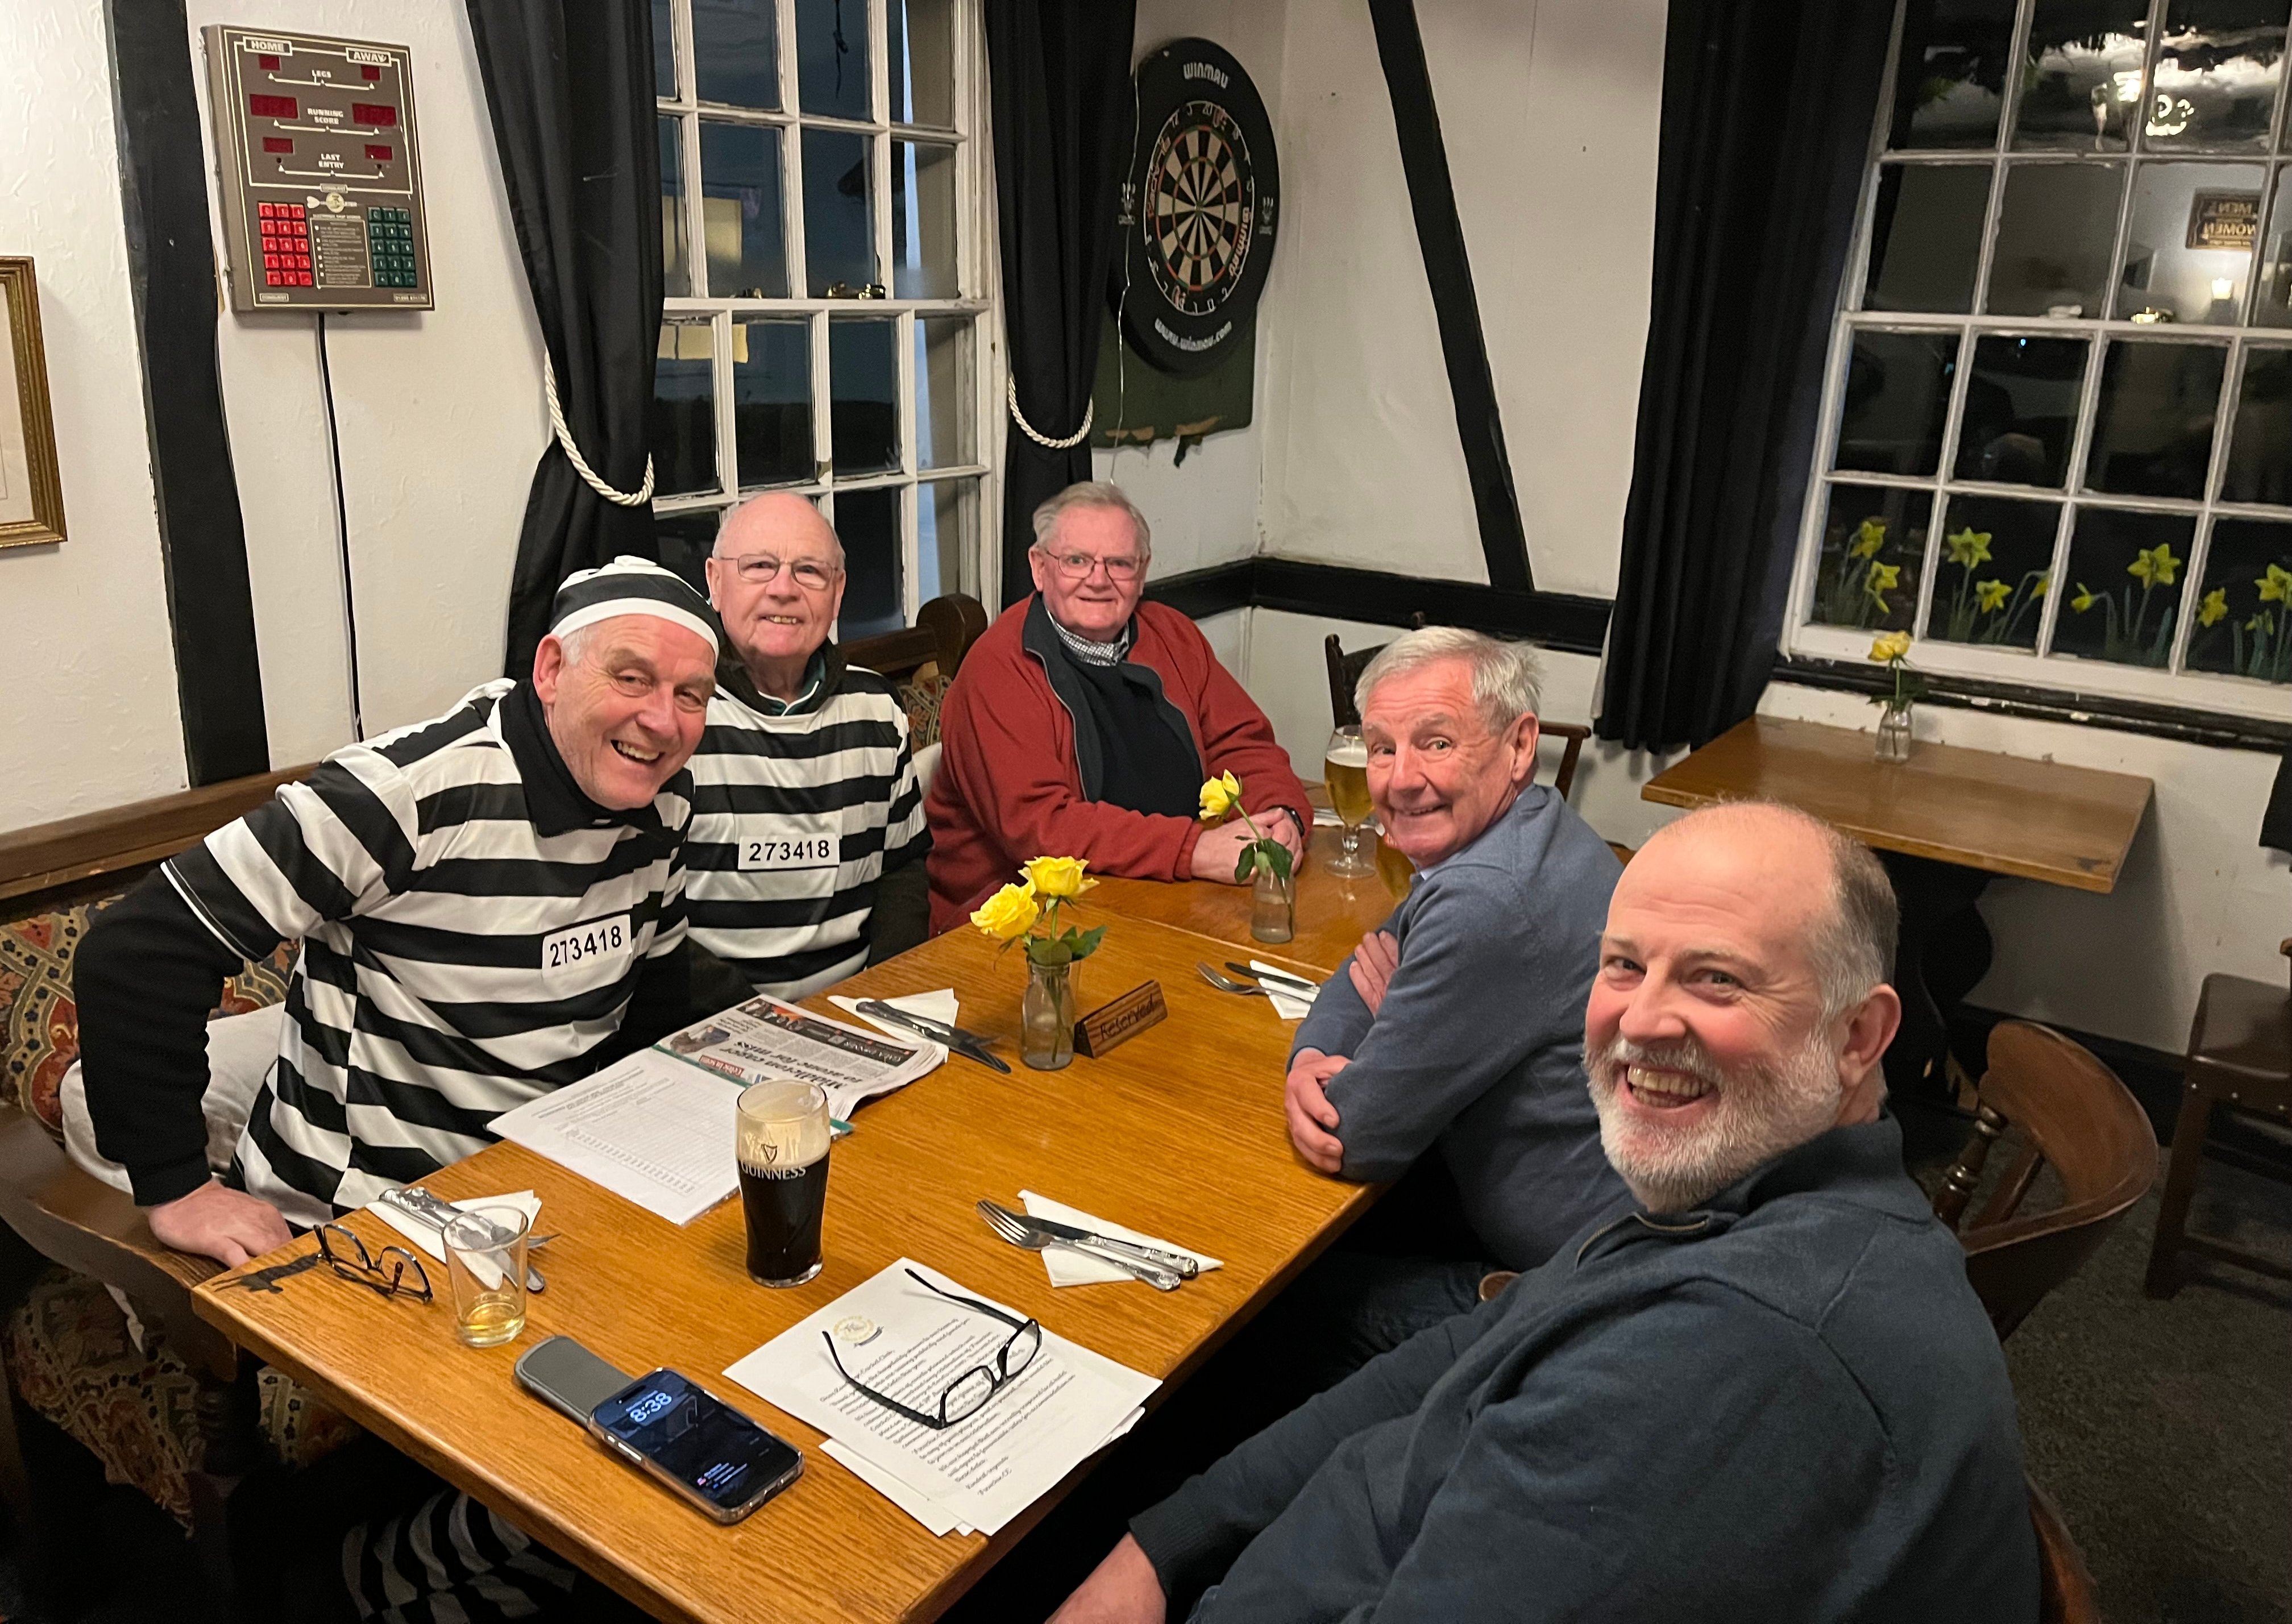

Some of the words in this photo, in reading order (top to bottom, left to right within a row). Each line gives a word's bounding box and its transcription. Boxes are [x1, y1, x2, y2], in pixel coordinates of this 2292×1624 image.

[251, 40, 285, 52] HOME
[353, 51, 387, 63] AWAY
[312, 69, 331, 78] LEGS
[307, 108, 344, 118] RUNNING
[318, 160, 344, 169] ENTRY
[749, 840, 830, 862] 273418
[550, 925, 622, 968] 273418
[741, 1160, 806, 1180] GUINNESS
[630, 1392, 672, 1422] 8:38
